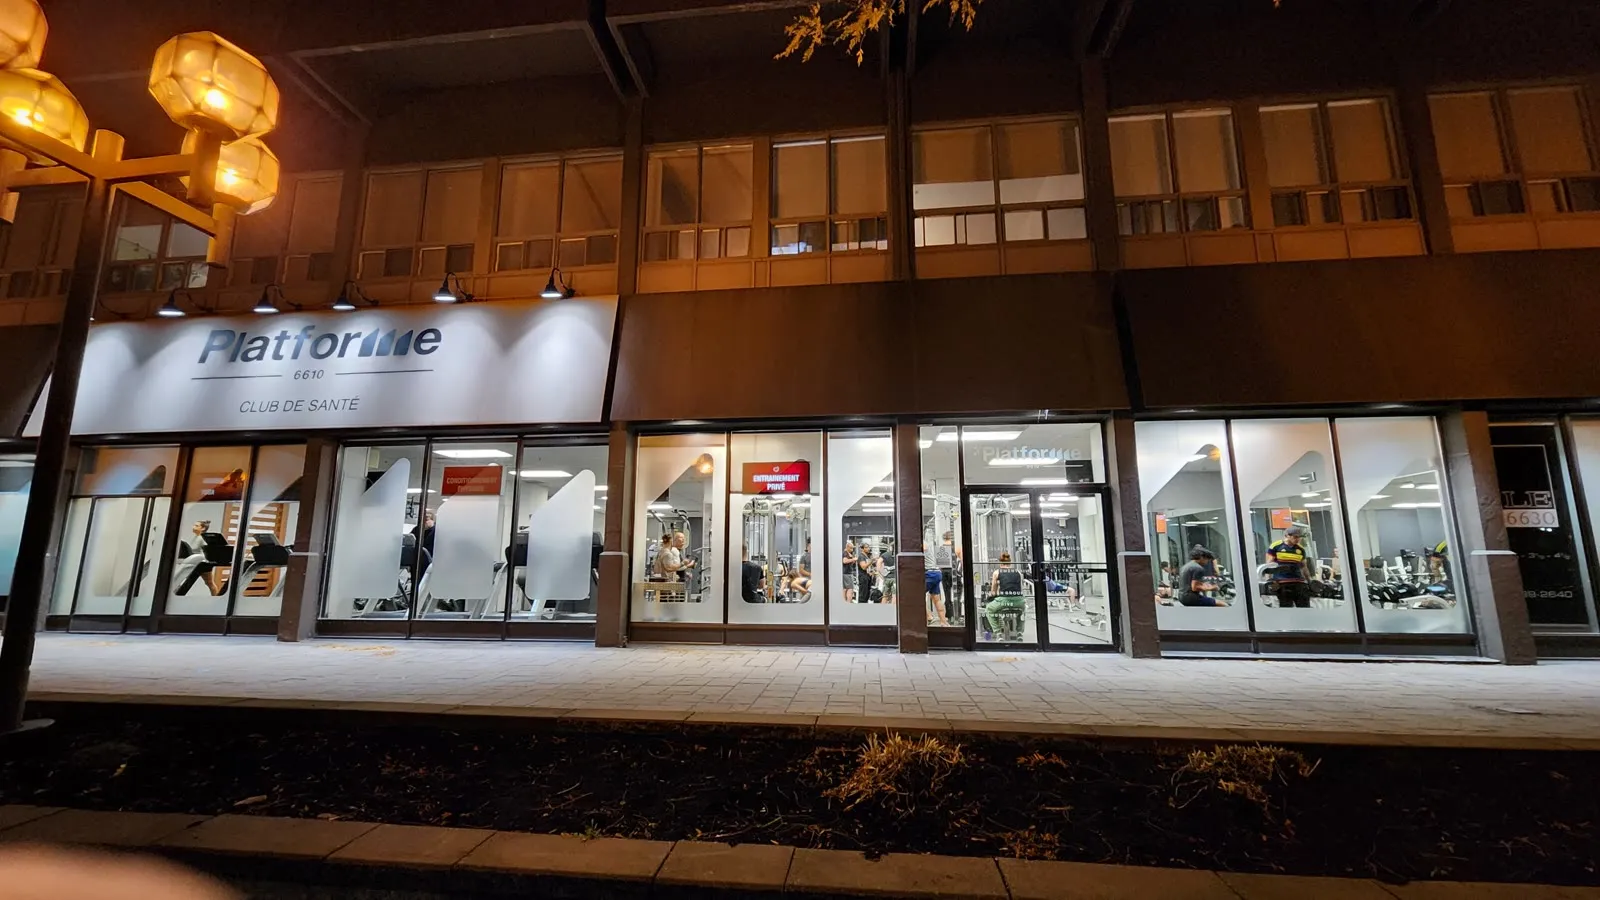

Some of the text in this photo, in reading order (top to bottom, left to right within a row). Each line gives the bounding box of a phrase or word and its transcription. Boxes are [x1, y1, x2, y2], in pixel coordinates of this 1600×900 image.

[293, 369, 325, 380] 6610
[239, 395, 361, 413] CLUB DE SANTÉ
[1507, 511, 1556, 526] 6630
